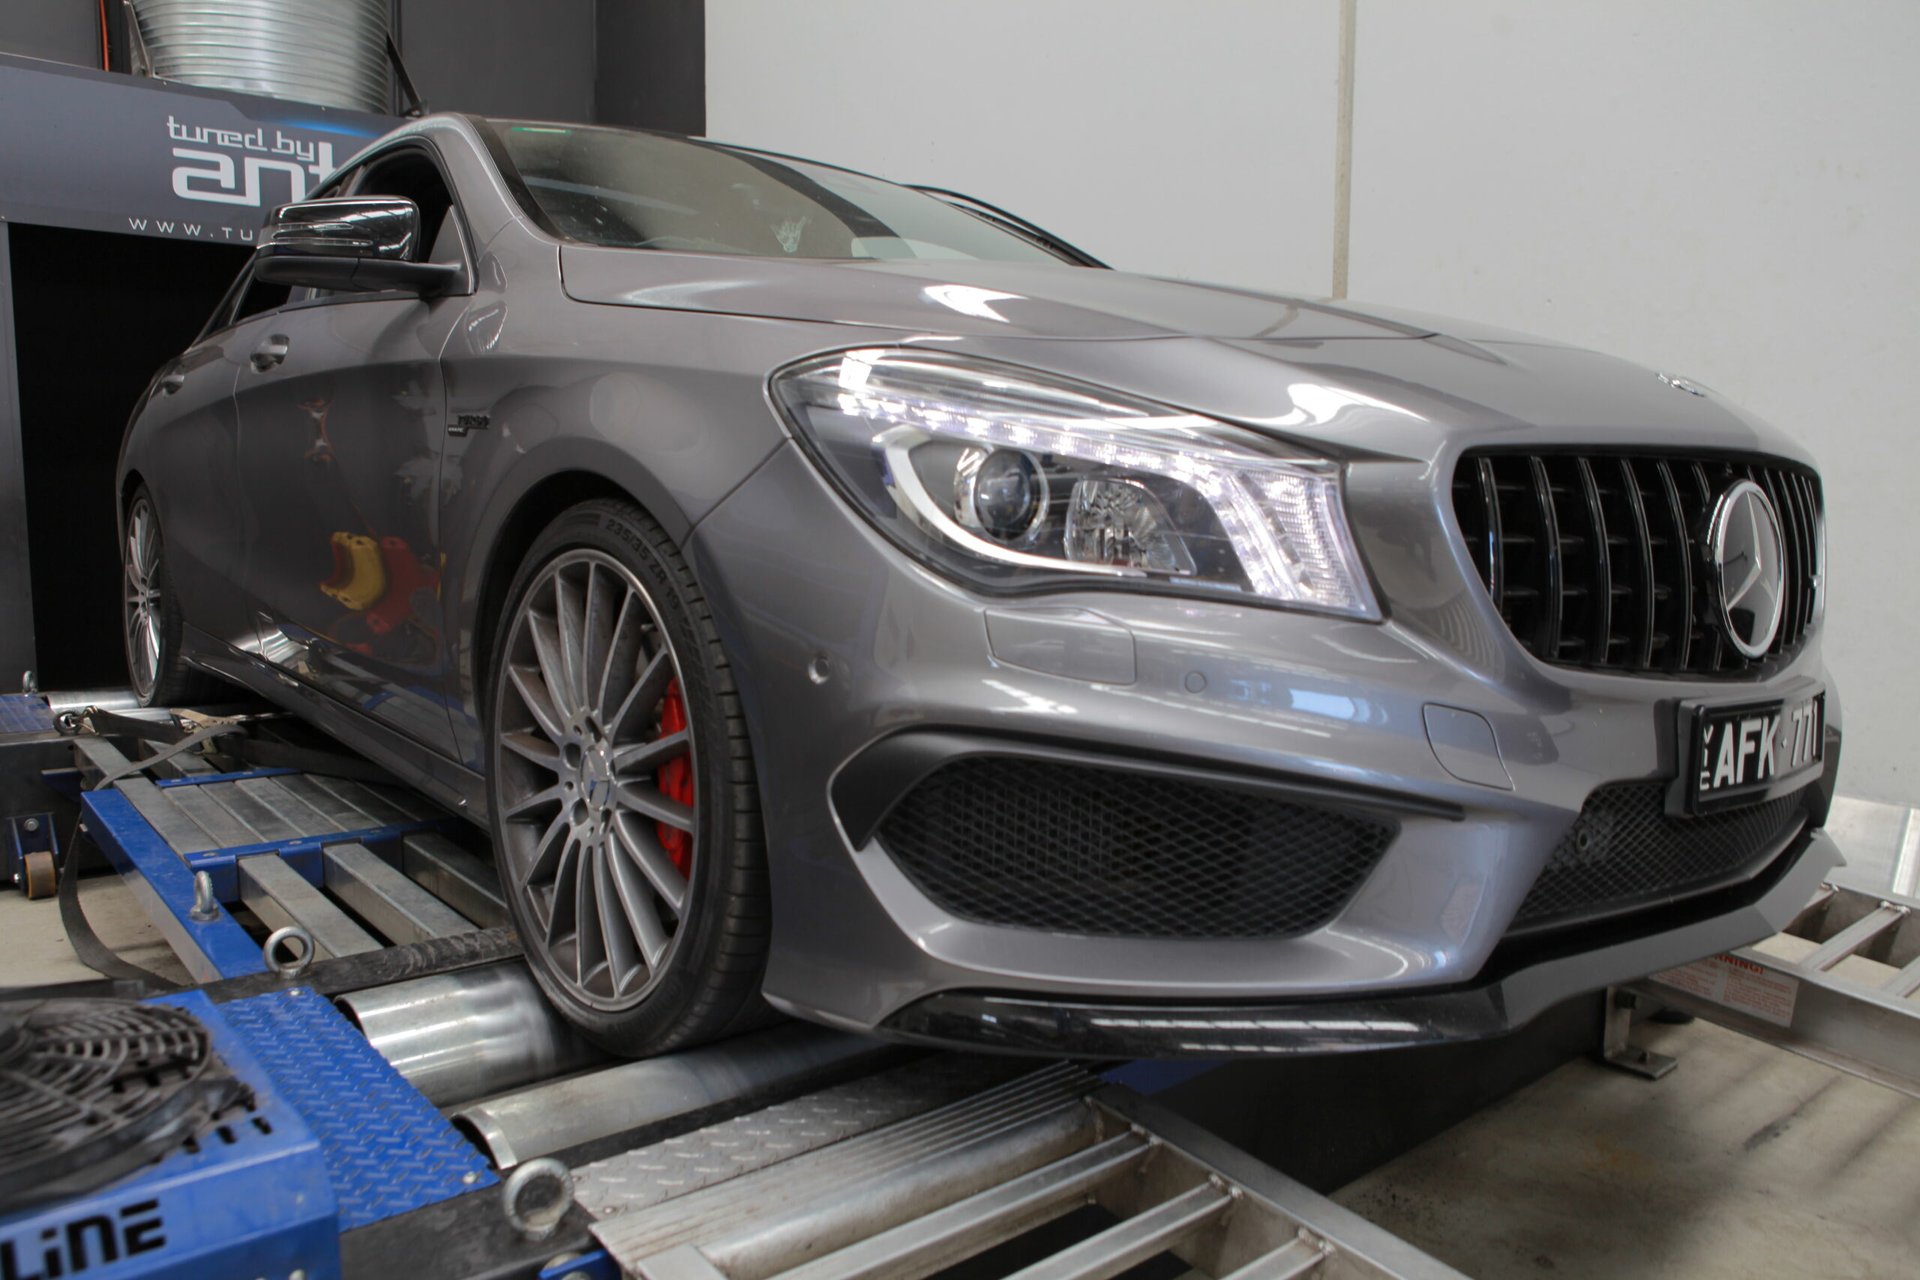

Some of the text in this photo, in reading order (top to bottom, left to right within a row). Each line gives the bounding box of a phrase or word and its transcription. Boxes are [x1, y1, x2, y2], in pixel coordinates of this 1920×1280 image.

[166, 115, 315, 162] tuned by
[128, 217, 253, 241] WWW.TU
[1713, 714, 1781, 789] AFK
